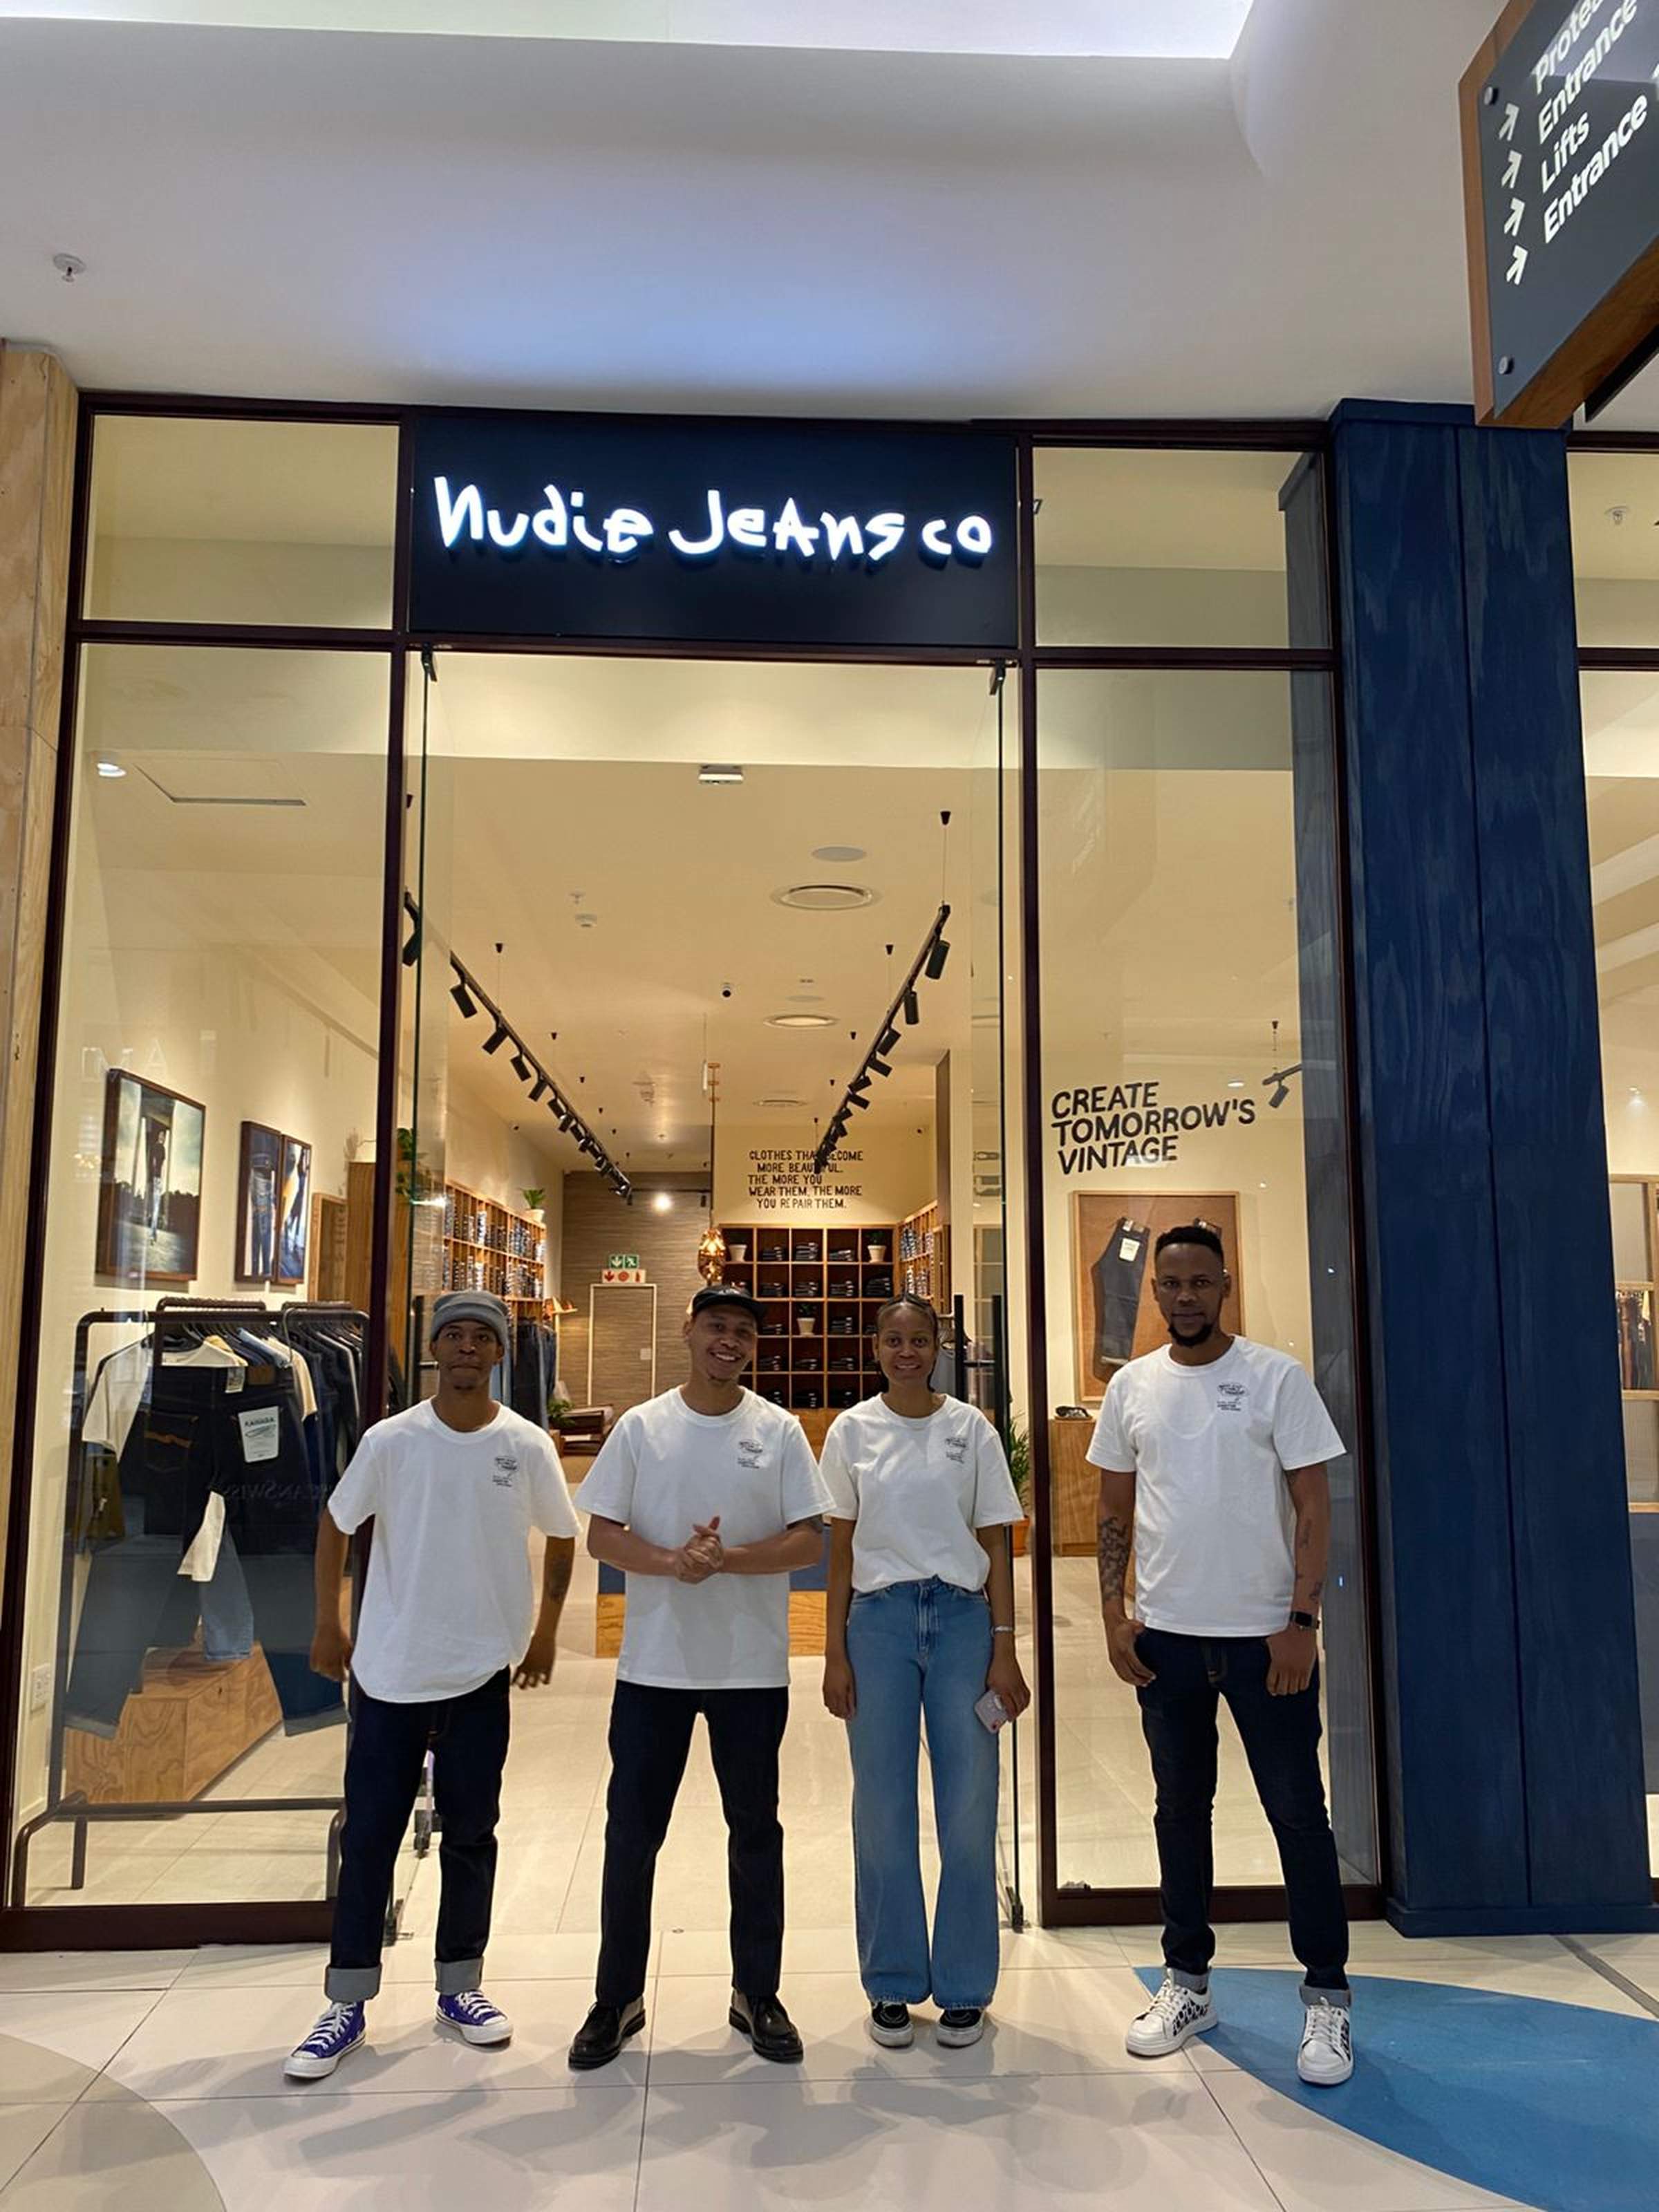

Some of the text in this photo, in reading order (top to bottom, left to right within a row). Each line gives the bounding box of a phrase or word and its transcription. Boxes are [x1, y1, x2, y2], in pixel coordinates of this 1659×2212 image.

[1539, 0, 1637, 144] Entrance
[1541, 111, 1589, 194] Lifts
[1543, 94, 1648, 244] Entrance
[1051, 1081, 1159, 1119] CREATE
[1051, 1099, 1255, 1146] TOMORROW'S
[749, 1150, 863, 1161] CLOTHES THA ECOME
[757, 1163, 784, 1173] MORE
[1058, 1135, 1179, 1174] VINTAGE
[748, 1174, 823, 1185] THE MORE YOU
[748, 1185, 776, 1196] WEAR
[812, 1185, 831, 1195] THE
[834, 1185, 863, 1196] MORE
[757, 1198, 776, 1208] YOU
